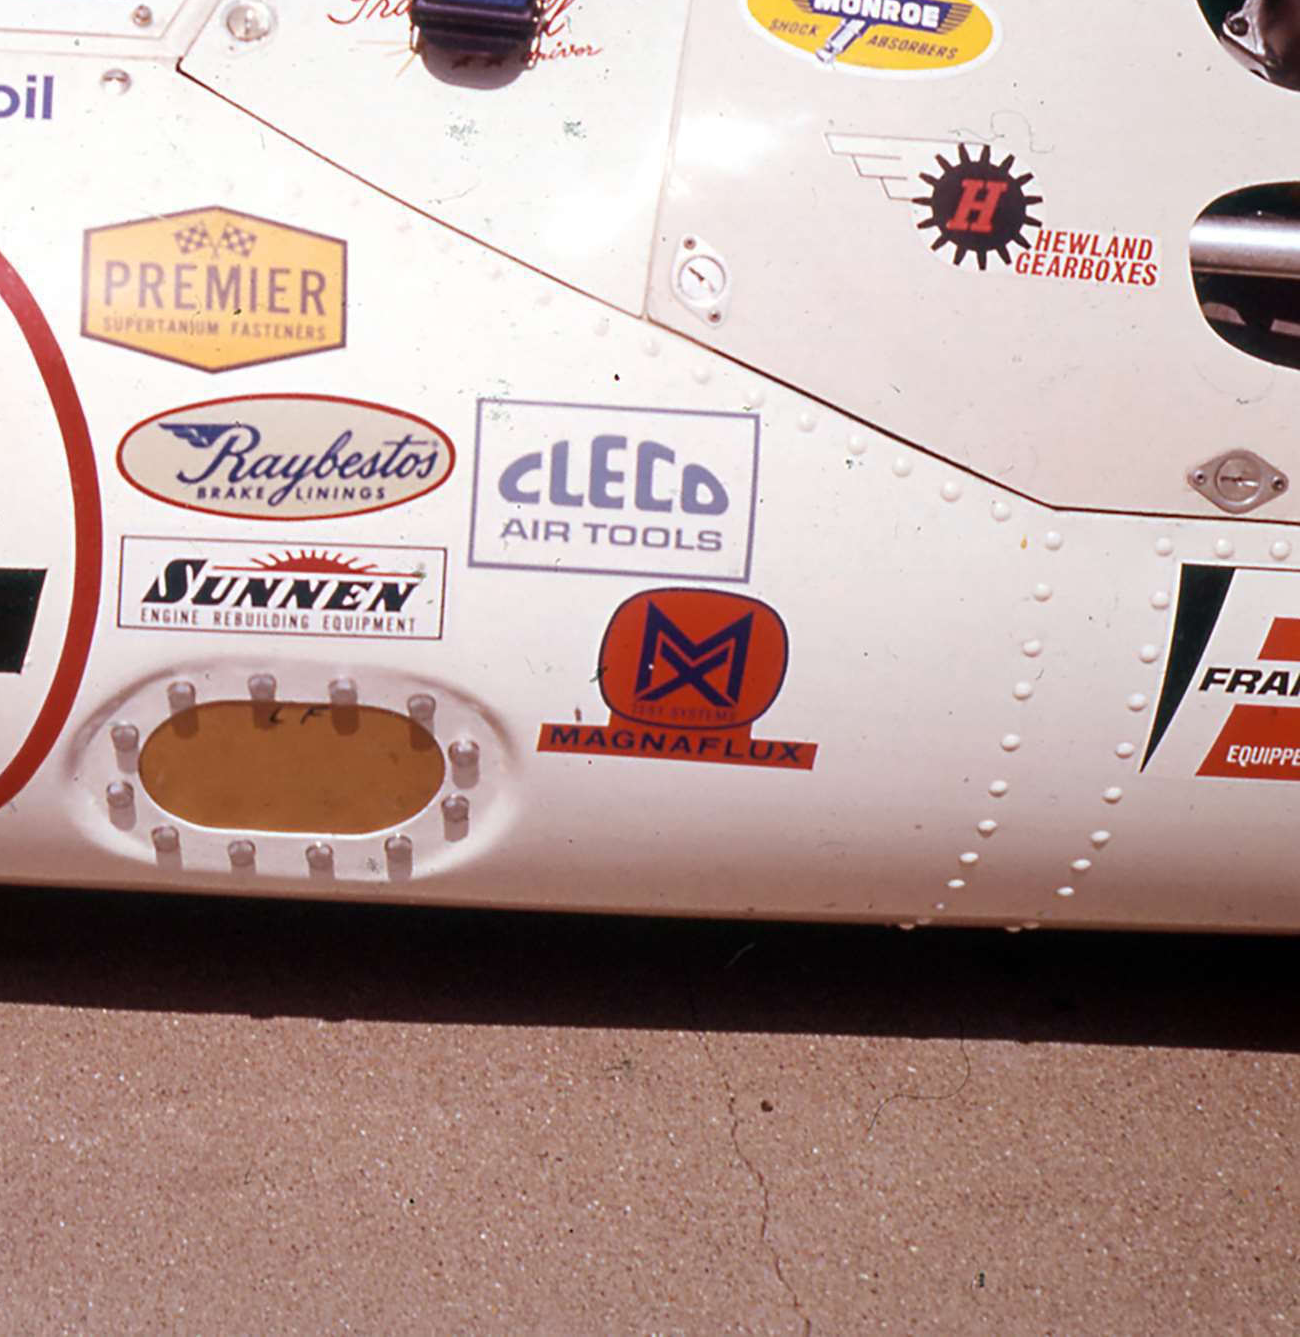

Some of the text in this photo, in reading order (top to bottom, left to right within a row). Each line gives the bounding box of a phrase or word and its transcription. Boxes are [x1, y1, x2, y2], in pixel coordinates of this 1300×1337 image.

[769, 18, 958, 60] SHOCK ABSORBERS
[946, 178, 1008, 234] H
[1034, 229, 1153, 261] HEWLAND
[1015, 252, 1158, 287] GEARBOXES
[103, 260, 327, 316] PREMIER
[103, 317, 326, 341] SUPERTANIUM FASTENERS
[168, 423, 440, 506] Raybestos
[497, 433, 730, 516] CLECO
[196, 485, 386, 501] BRAKE LININGS
[500, 518, 723, 552] AIR TOOLS
[141, 558, 422, 613] SUNNEN
[141, 607, 416, 633] ENGINE REBUILDING EQUIPMENT
[1198, 666, 1300, 697] FRA
[549, 726, 803, 762] MAGNAFLUX
